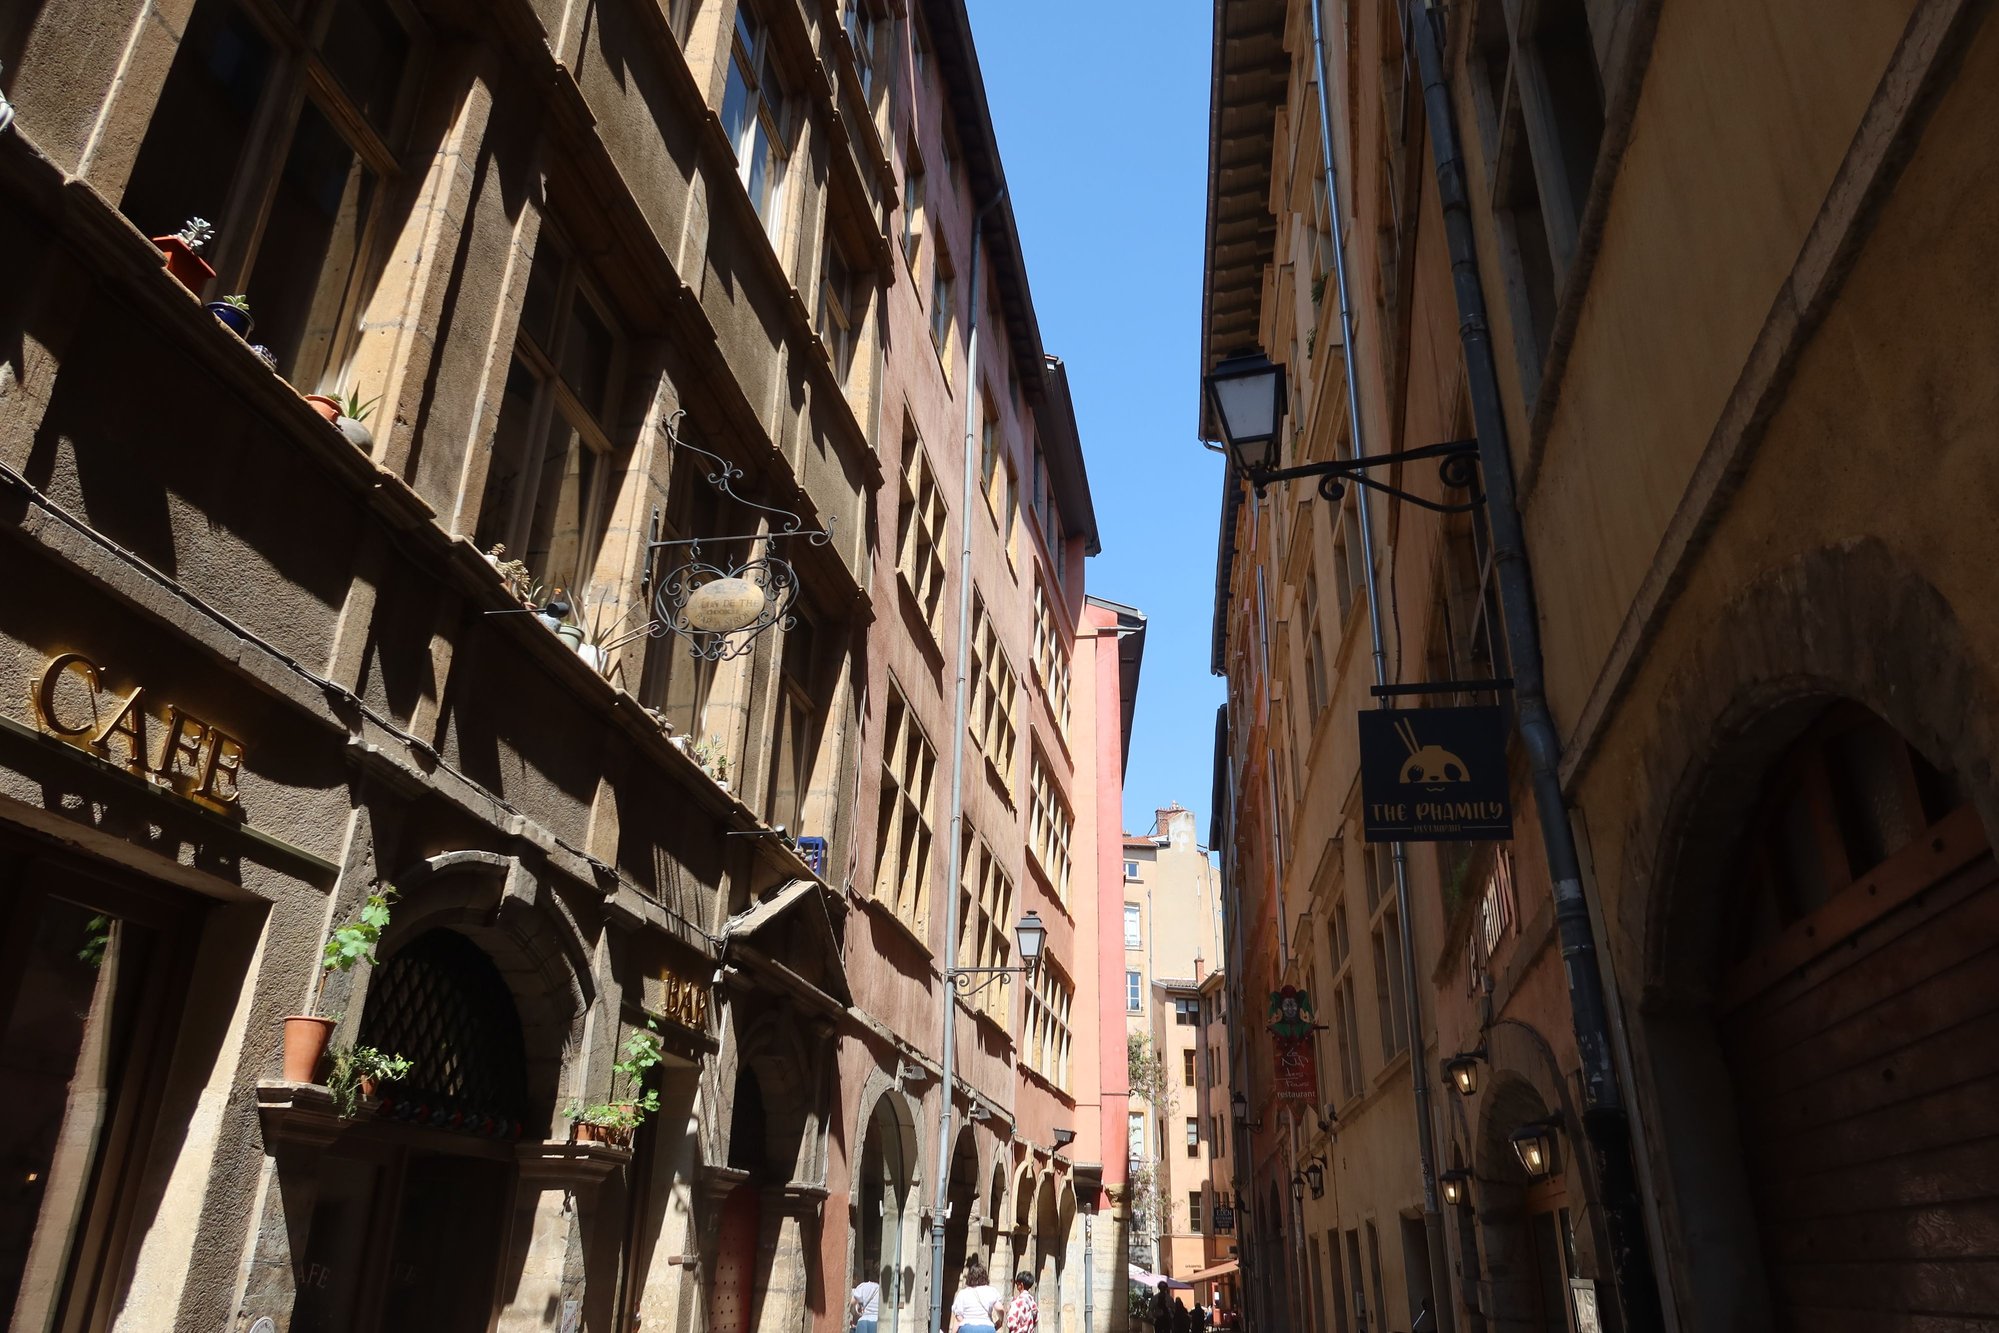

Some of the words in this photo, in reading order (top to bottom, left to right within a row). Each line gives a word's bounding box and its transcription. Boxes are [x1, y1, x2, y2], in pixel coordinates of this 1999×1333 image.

[37, 653, 246, 802] CAFE
[1370, 803, 1408, 822] THE
[1416, 801, 1504, 822] PHAMILY
[664, 970, 708, 1026] BAR
[1277, 1090, 1315, 1099] restaurant
